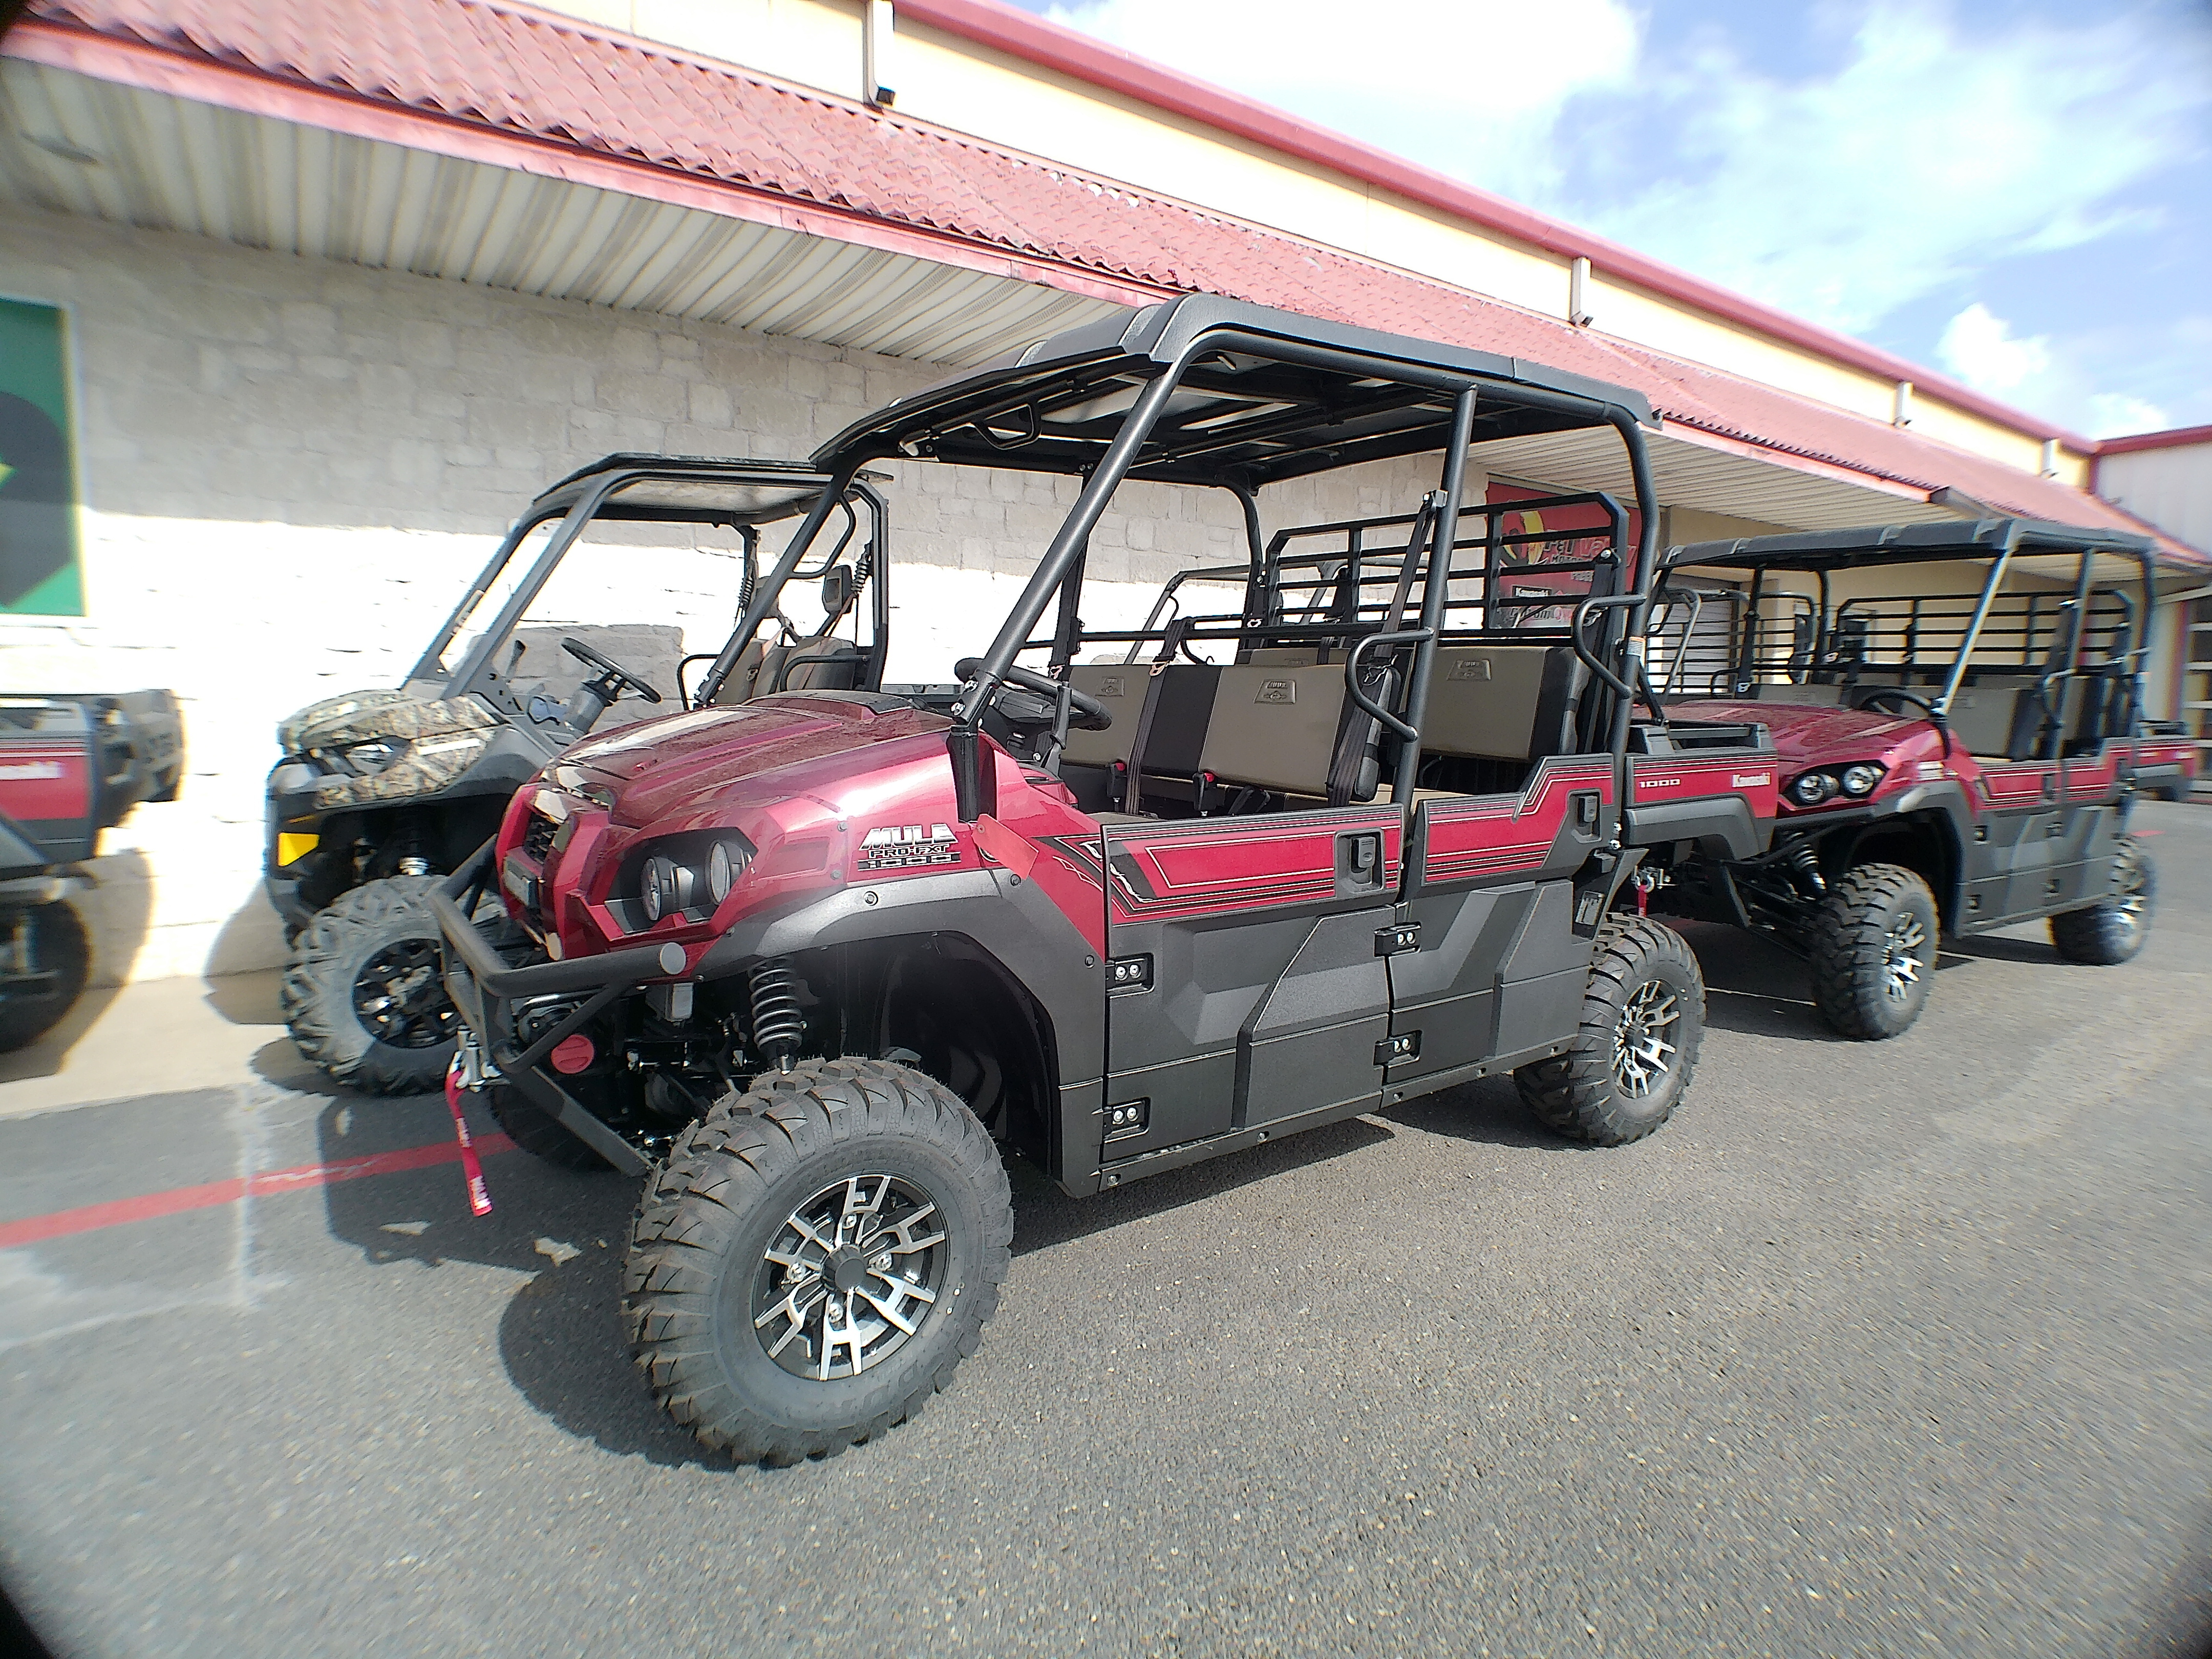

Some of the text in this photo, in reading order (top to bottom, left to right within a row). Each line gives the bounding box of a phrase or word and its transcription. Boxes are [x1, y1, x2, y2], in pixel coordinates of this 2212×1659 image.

[1639, 778, 1681, 788] 1000
[859, 823, 959, 850] MULE
[868, 844, 950, 859] PRO-FXT
[867, 854, 952, 869] 1000
